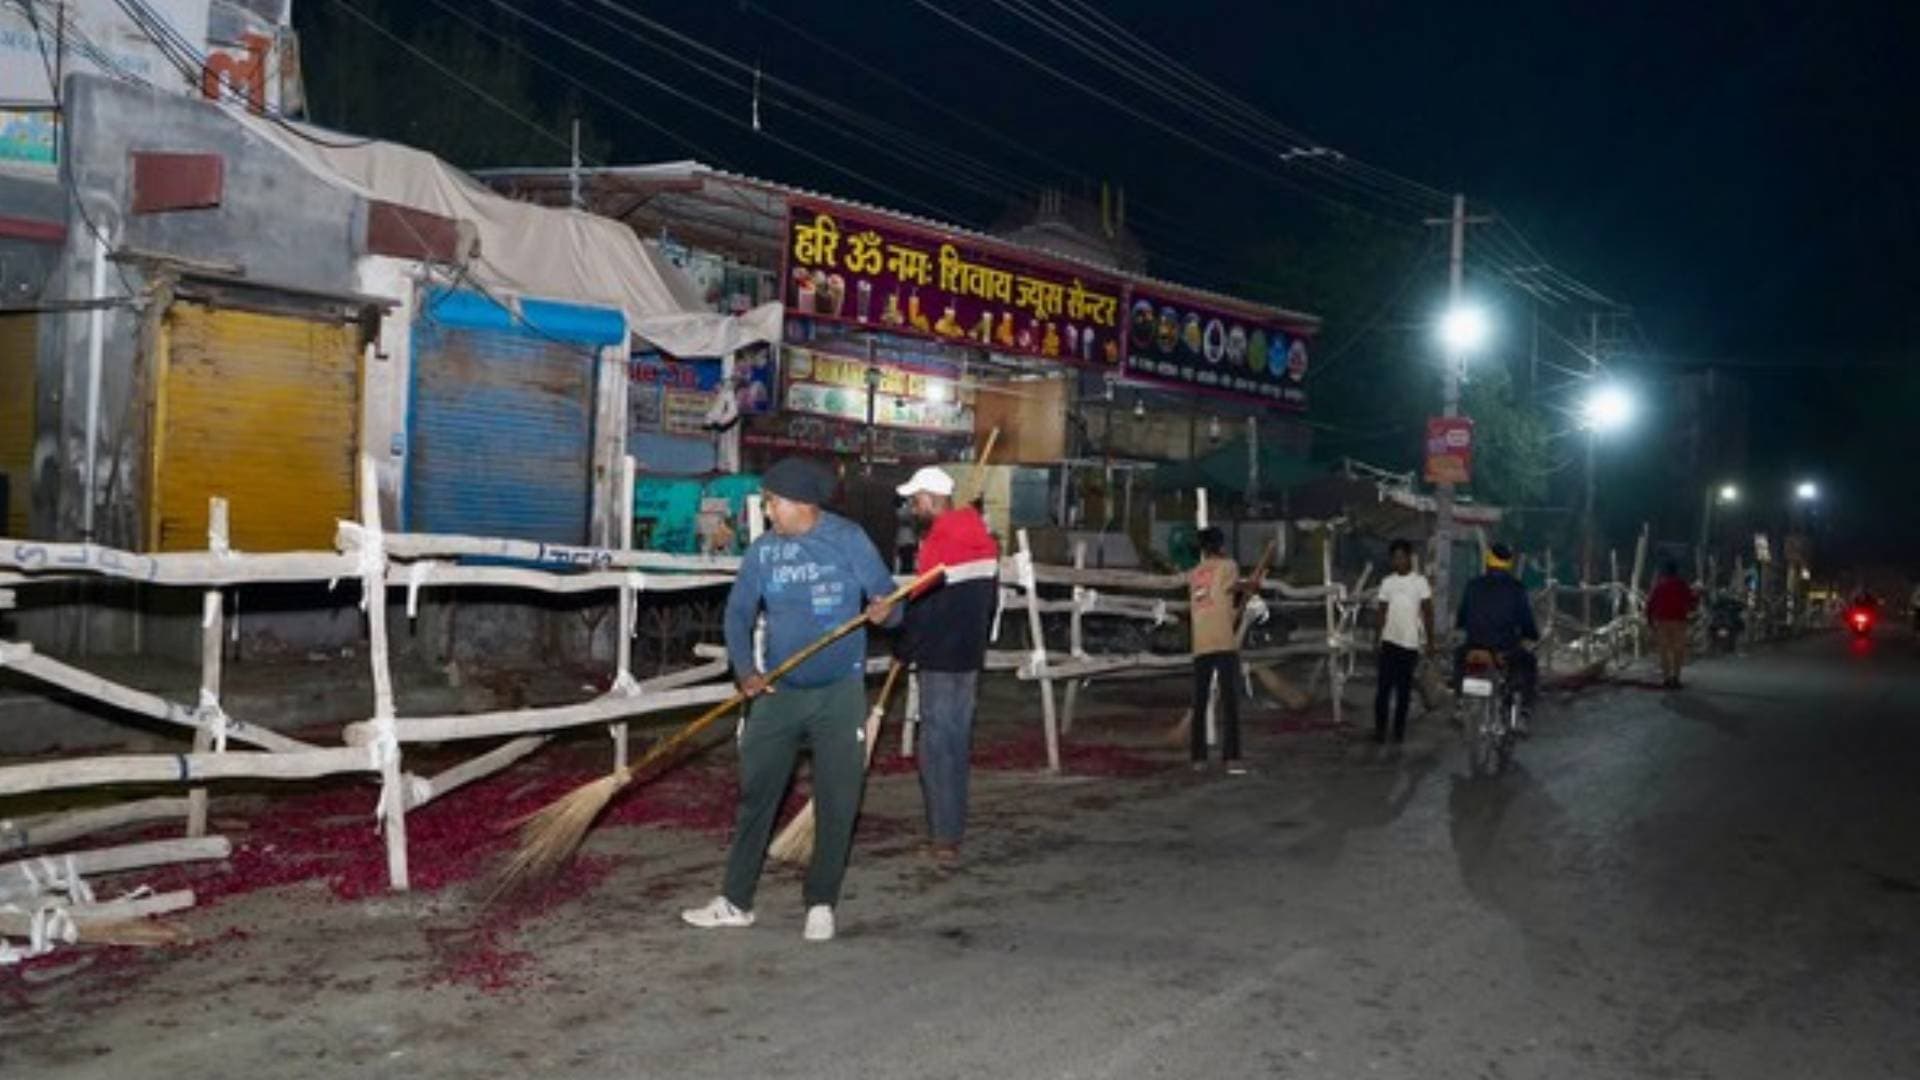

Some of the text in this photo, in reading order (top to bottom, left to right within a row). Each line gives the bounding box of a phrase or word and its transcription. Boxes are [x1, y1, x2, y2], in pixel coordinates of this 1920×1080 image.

[794, 215, 838, 266] हरि
[889, 245, 932, 285] नमः
[939, 246, 1012, 304] शिवाय
